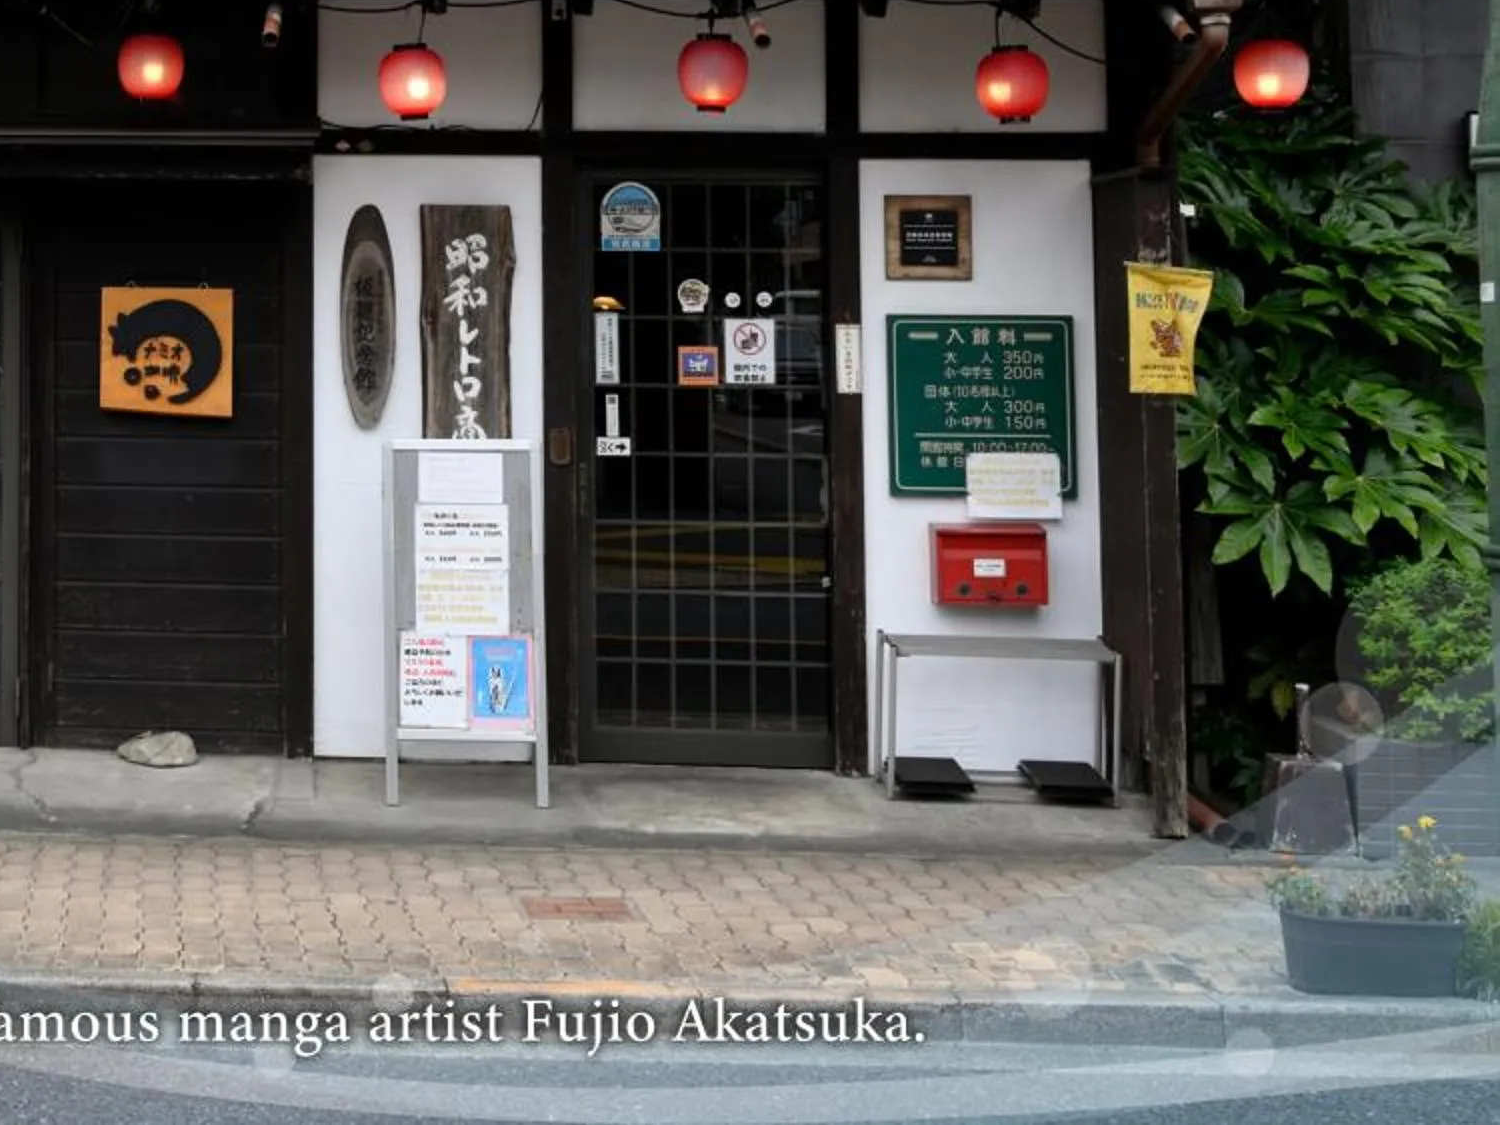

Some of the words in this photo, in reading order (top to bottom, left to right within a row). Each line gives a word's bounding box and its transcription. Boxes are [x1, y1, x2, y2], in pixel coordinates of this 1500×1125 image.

[143, 341, 185, 362] ナミオ
[1002, 350, 1045, 365] 350円
[1003, 365, 1045, 380] 200円
[1003, 400, 1045, 414] 300円
[1004, 415, 1047, 430] 150円
